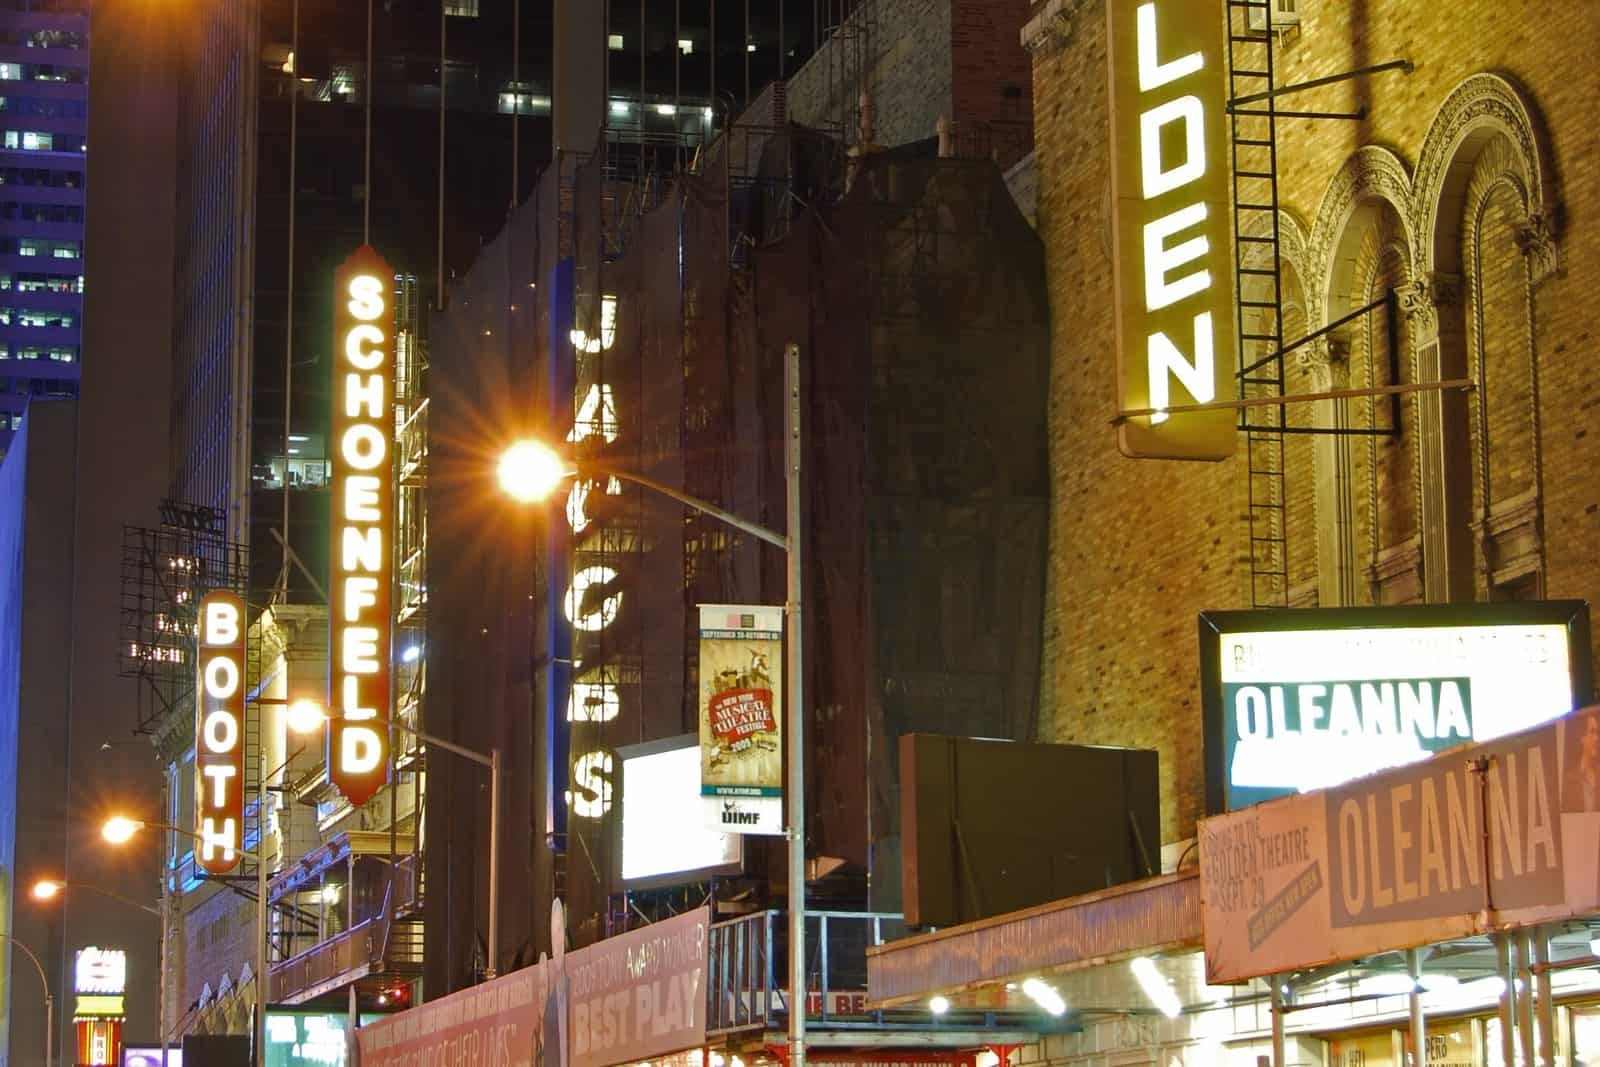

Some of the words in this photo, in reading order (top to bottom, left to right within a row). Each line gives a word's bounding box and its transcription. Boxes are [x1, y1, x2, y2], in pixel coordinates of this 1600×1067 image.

[340, 275, 386, 775] SCHOENFELD
[202, 602, 239, 861] BOOTH
[714, 707, 771, 733] THEATRE
[716, 700, 764, 720] MUSICAL
[1234, 680, 1473, 742] OLEANNA
[1260, 826, 1311, 873] THEATRE
[1338, 745, 1558, 916] OLEANNA
[625, 938, 660, 980] AWARD
[575, 989, 631, 1056] BEST
[635, 968, 702, 1041] PLAY
